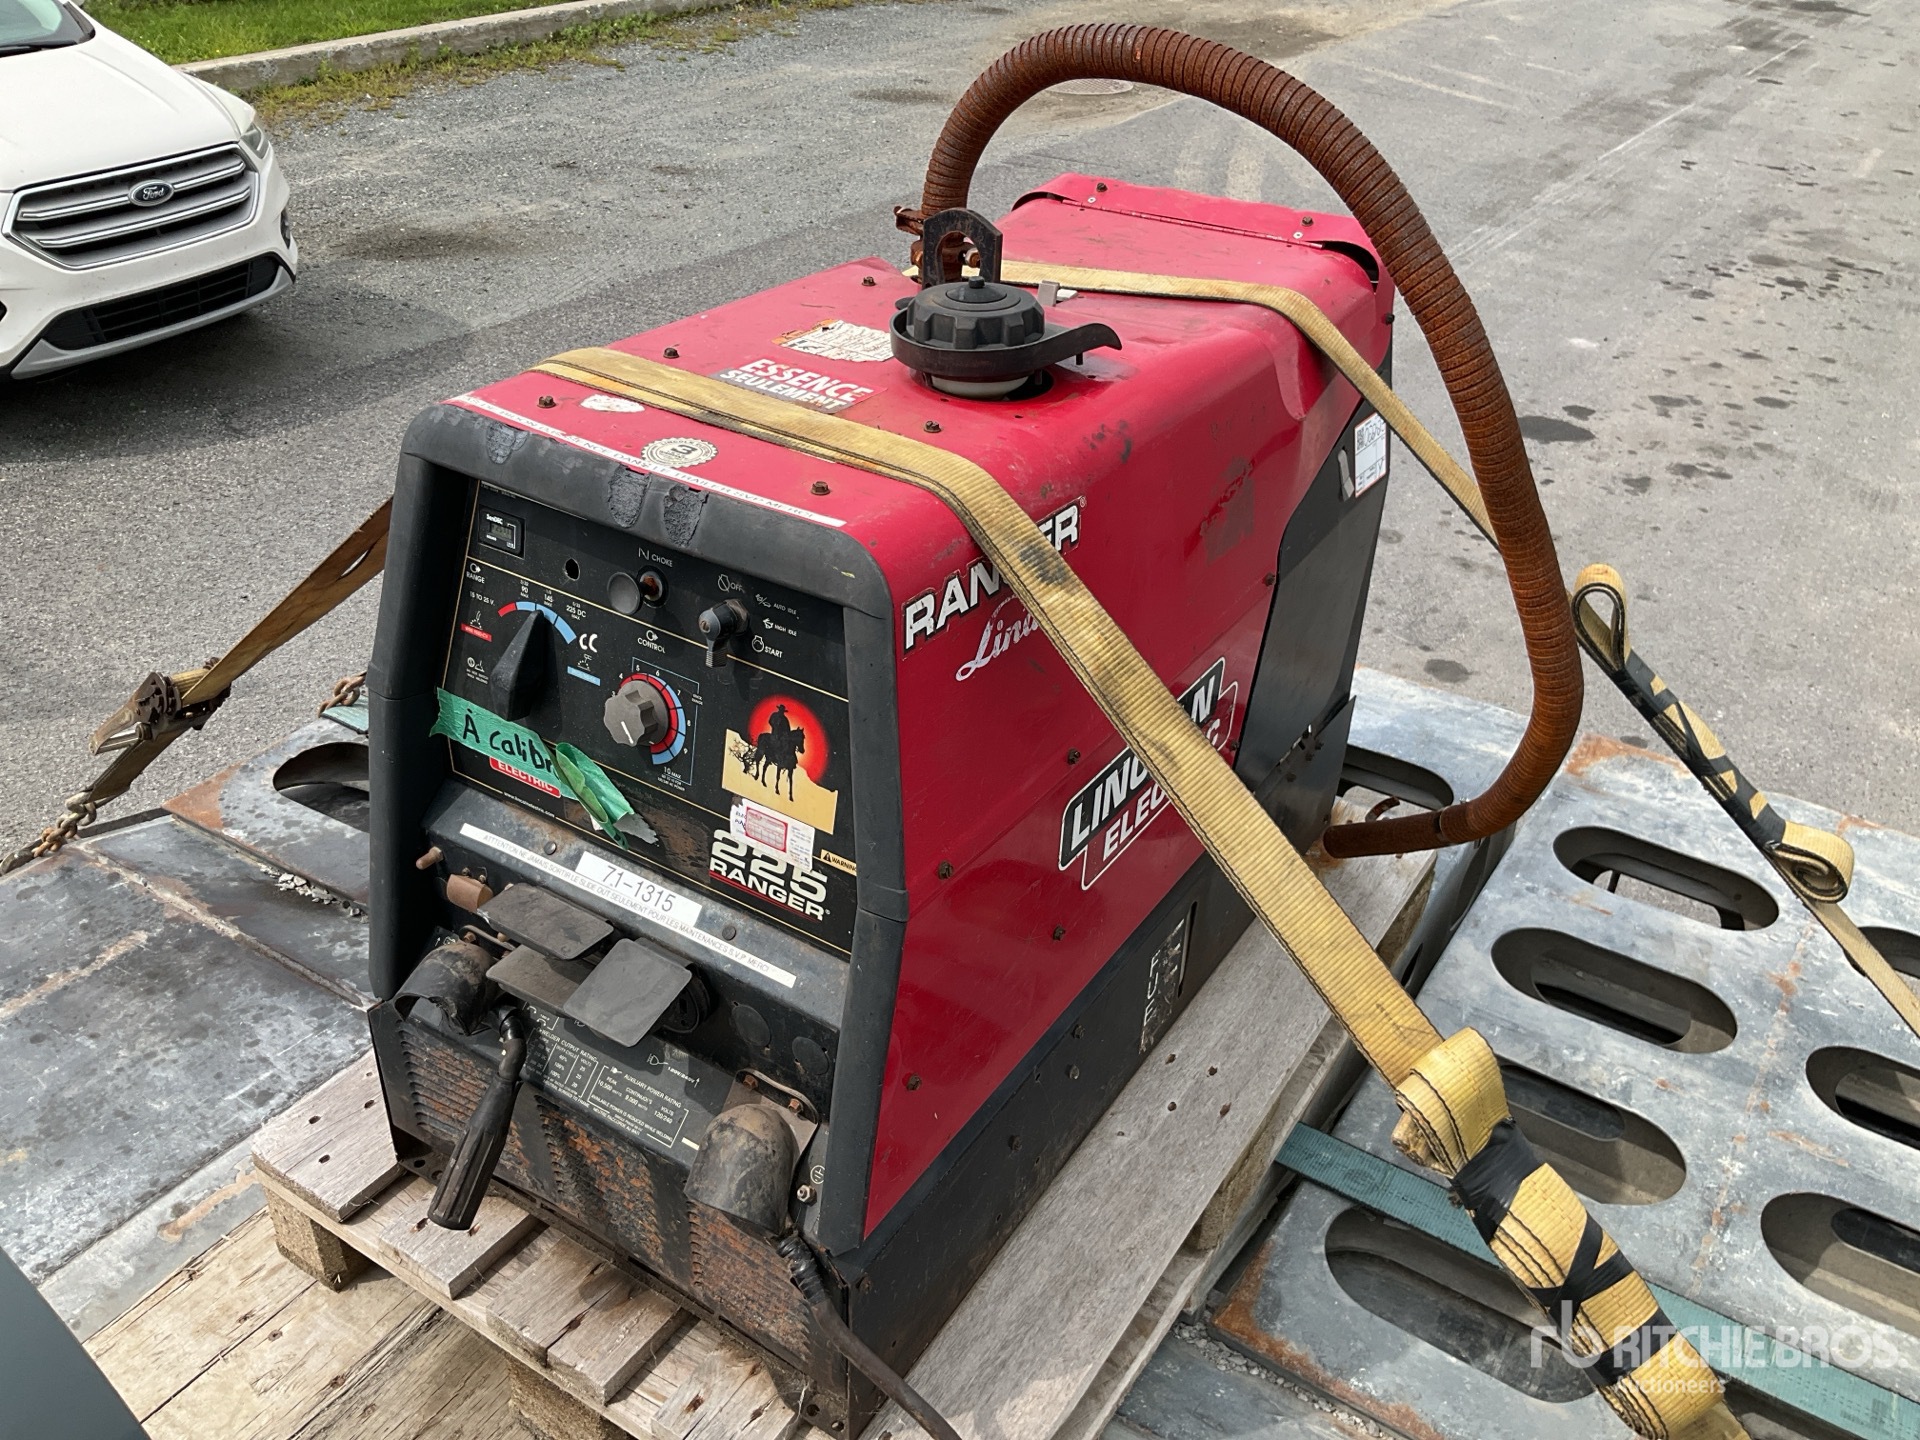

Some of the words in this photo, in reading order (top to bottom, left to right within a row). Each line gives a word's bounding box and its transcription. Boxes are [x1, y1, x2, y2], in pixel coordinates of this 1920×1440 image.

[142, 186, 165, 200] Ford
[739, 358, 874, 401] ESSENCE
[720, 370, 848, 410] SEULEMENT
[651, 553, 674, 568] CHOKE
[466, 571, 486, 584] RANGE
[566, 605, 577, 615] 225
[577, 609, 587, 618] DC
[773, 603, 786, 611] AUTO
[774, 624, 787, 632] HIGH
[637, 637, 666, 654] CONTROL
[764, 645, 783, 658] START
[664, 766, 671, 775] 10
[712, 829, 828, 904] 225
[710, 857, 826, 921] RANGER
[527, 851, 549, 868] JAMAIS
[548, 862, 571, 880] SORTIR
[578, 878, 596, 893] SLIDE
[596, 886, 611, 899] OUT
[611, 891, 648, 914] SEULEMENT
[649, 909, 666, 924] POUR
[667, 917, 679, 930] LES
[679, 921, 728, 954] MAINTENANCES
[747, 954, 770, 973] MERCI
[541, 1030, 561, 1043] WELDER
[560, 1039, 580, 1053] OUTPUT
[580, 1049, 598, 1063] RATING
[624, 1073, 647, 1090] AUXILIARY
[646, 1085, 664, 1099] POWER
[663, 1094, 682, 1108] RATING
